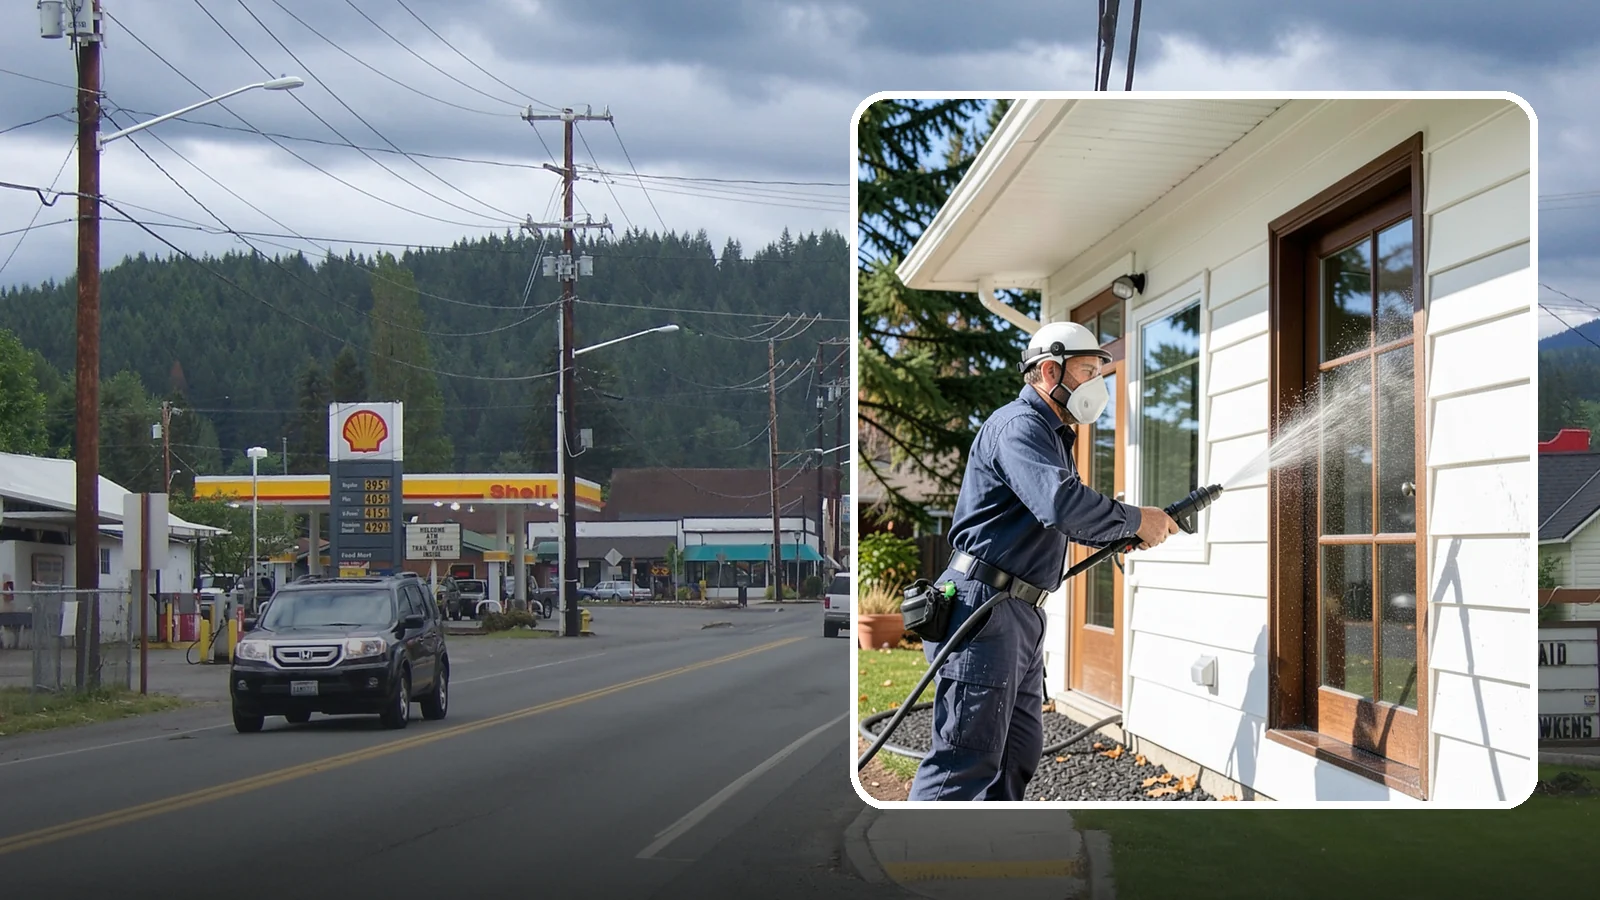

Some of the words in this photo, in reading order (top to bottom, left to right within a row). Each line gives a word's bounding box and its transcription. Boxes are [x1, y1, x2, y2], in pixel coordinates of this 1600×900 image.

[366, 480, 384, 490] 395
[490, 484, 547, 499] Shell
[366, 494, 384, 504] 405
[366, 508, 383, 518] 415
[366, 522, 383, 532] 429
